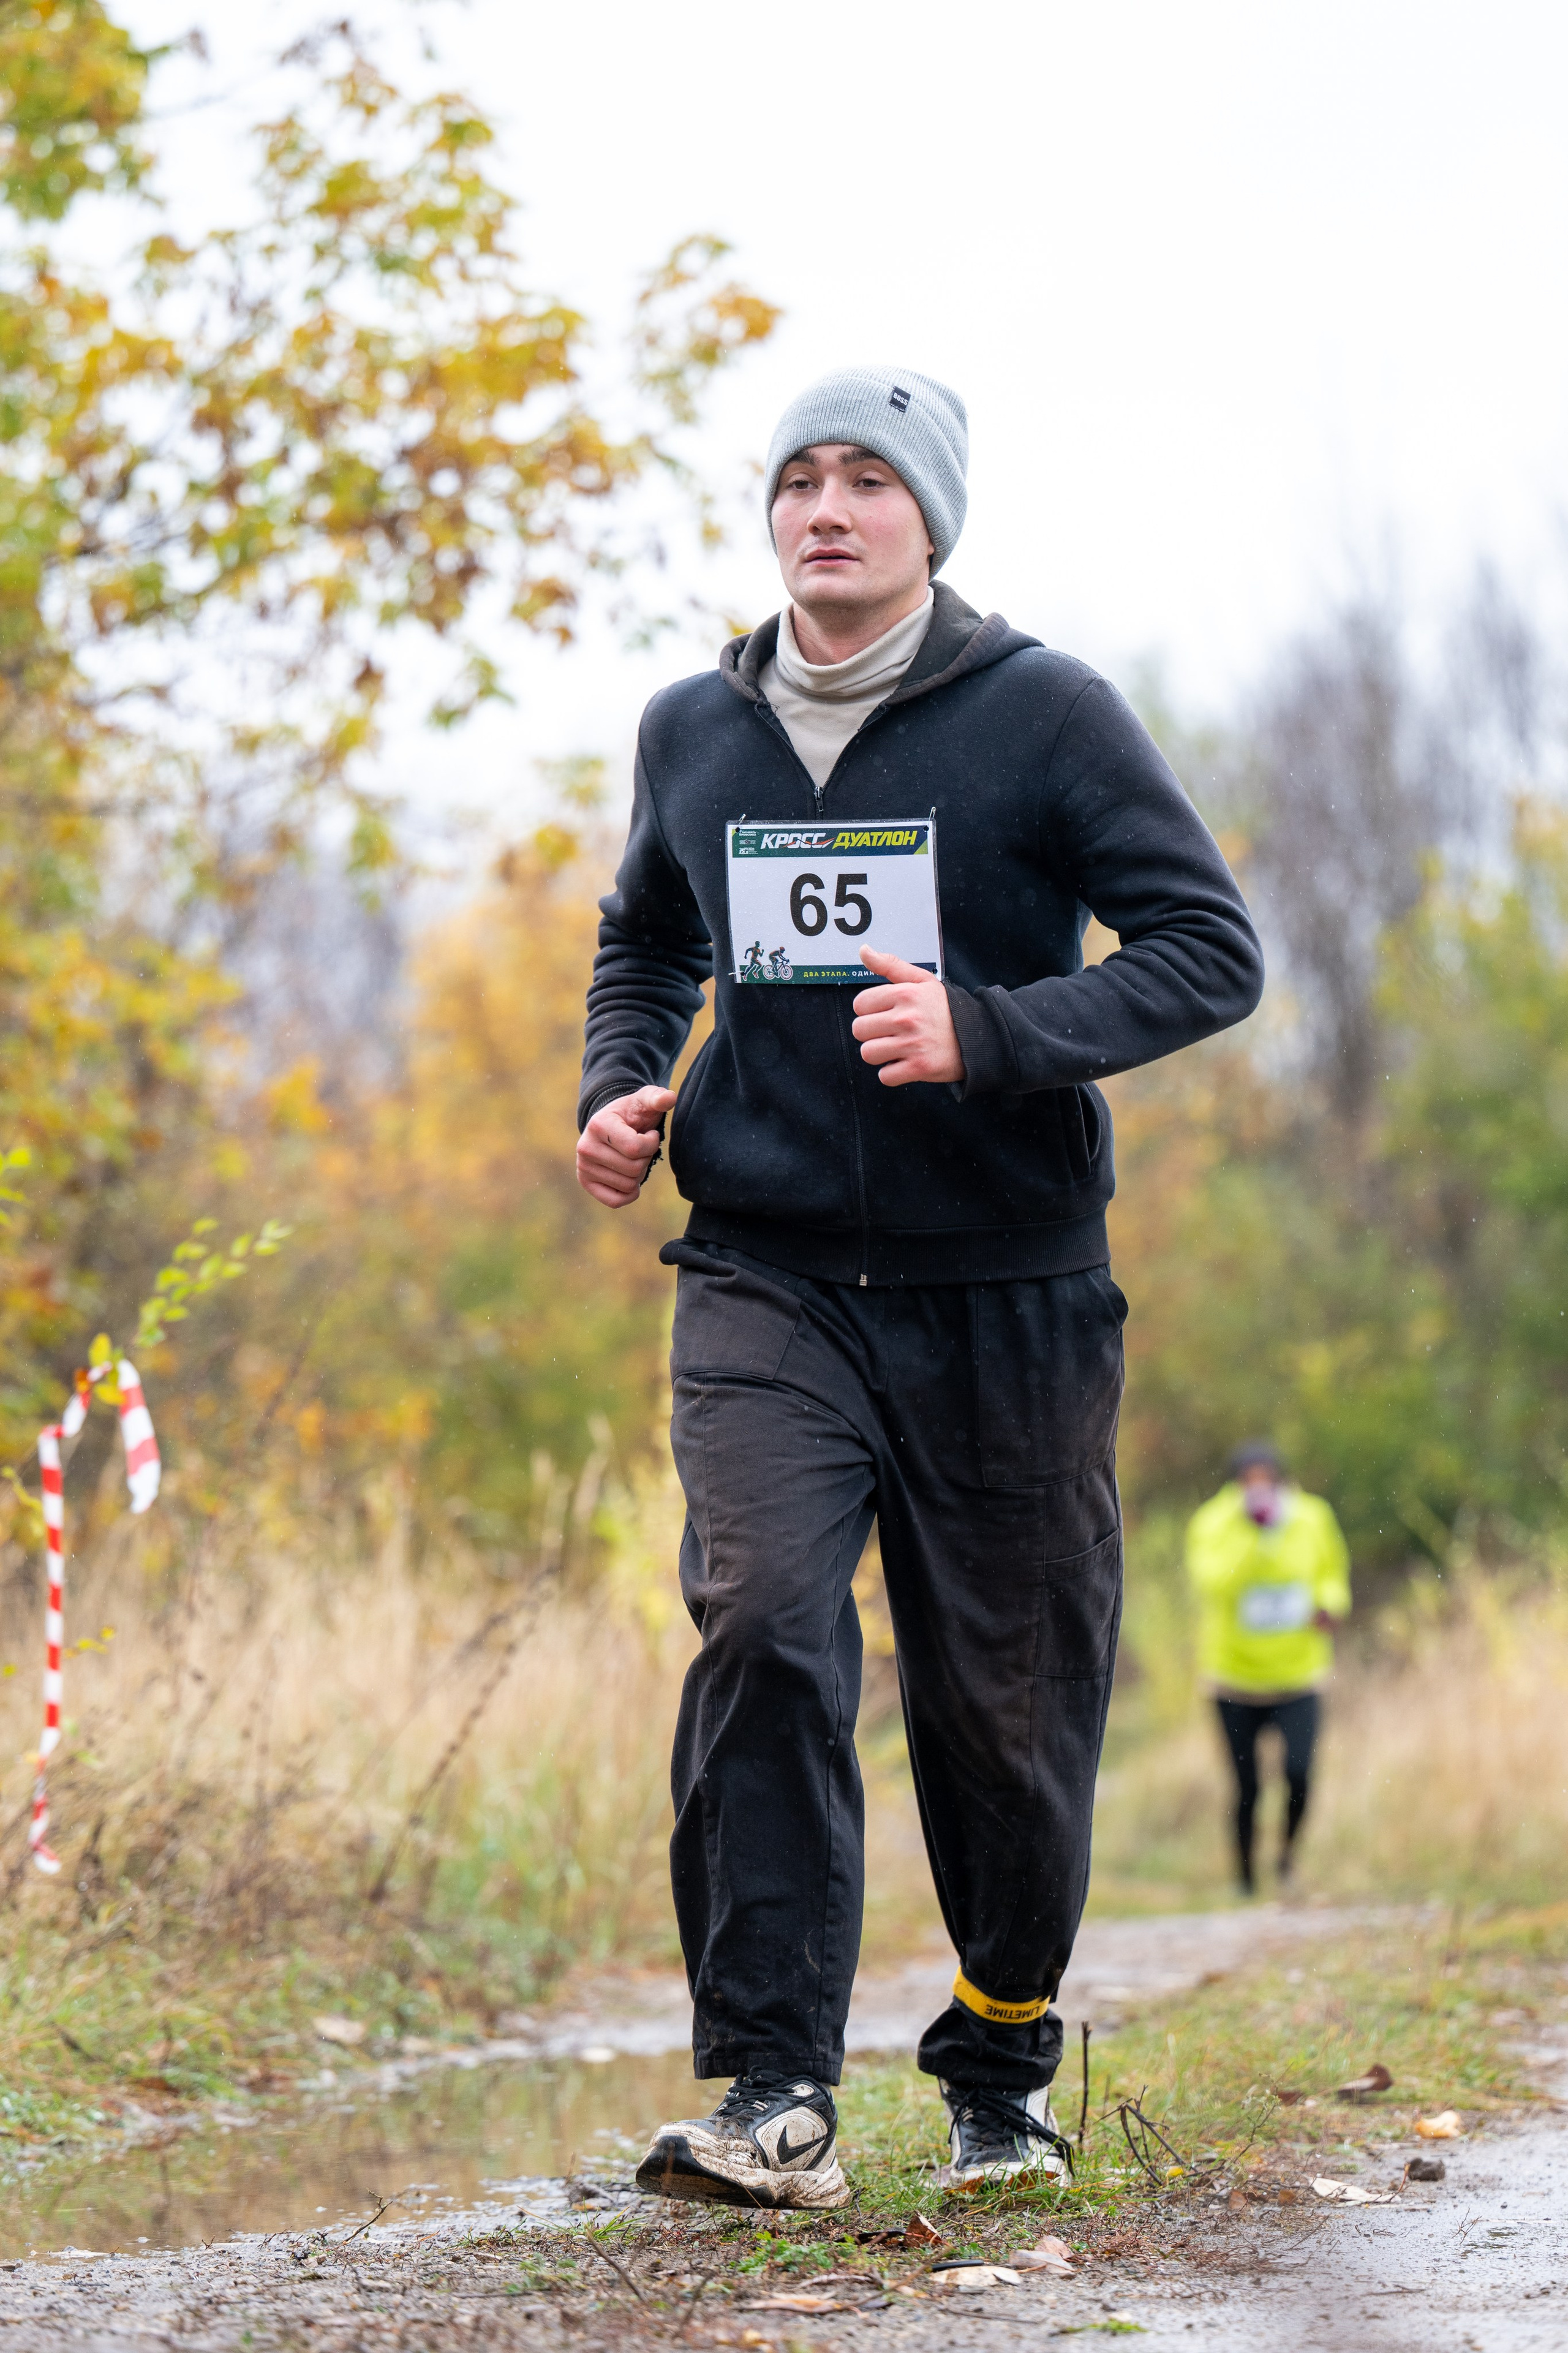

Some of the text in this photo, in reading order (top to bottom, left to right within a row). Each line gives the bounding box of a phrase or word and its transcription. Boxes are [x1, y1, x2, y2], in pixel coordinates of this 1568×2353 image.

[893, 392, 908, 406] BOSS
[760, 831, 918, 850] КРОСС ДУАТЛОН
[790, 873, 872, 936] 65
[984, 2004, 1041, 2019] LIMETIME
